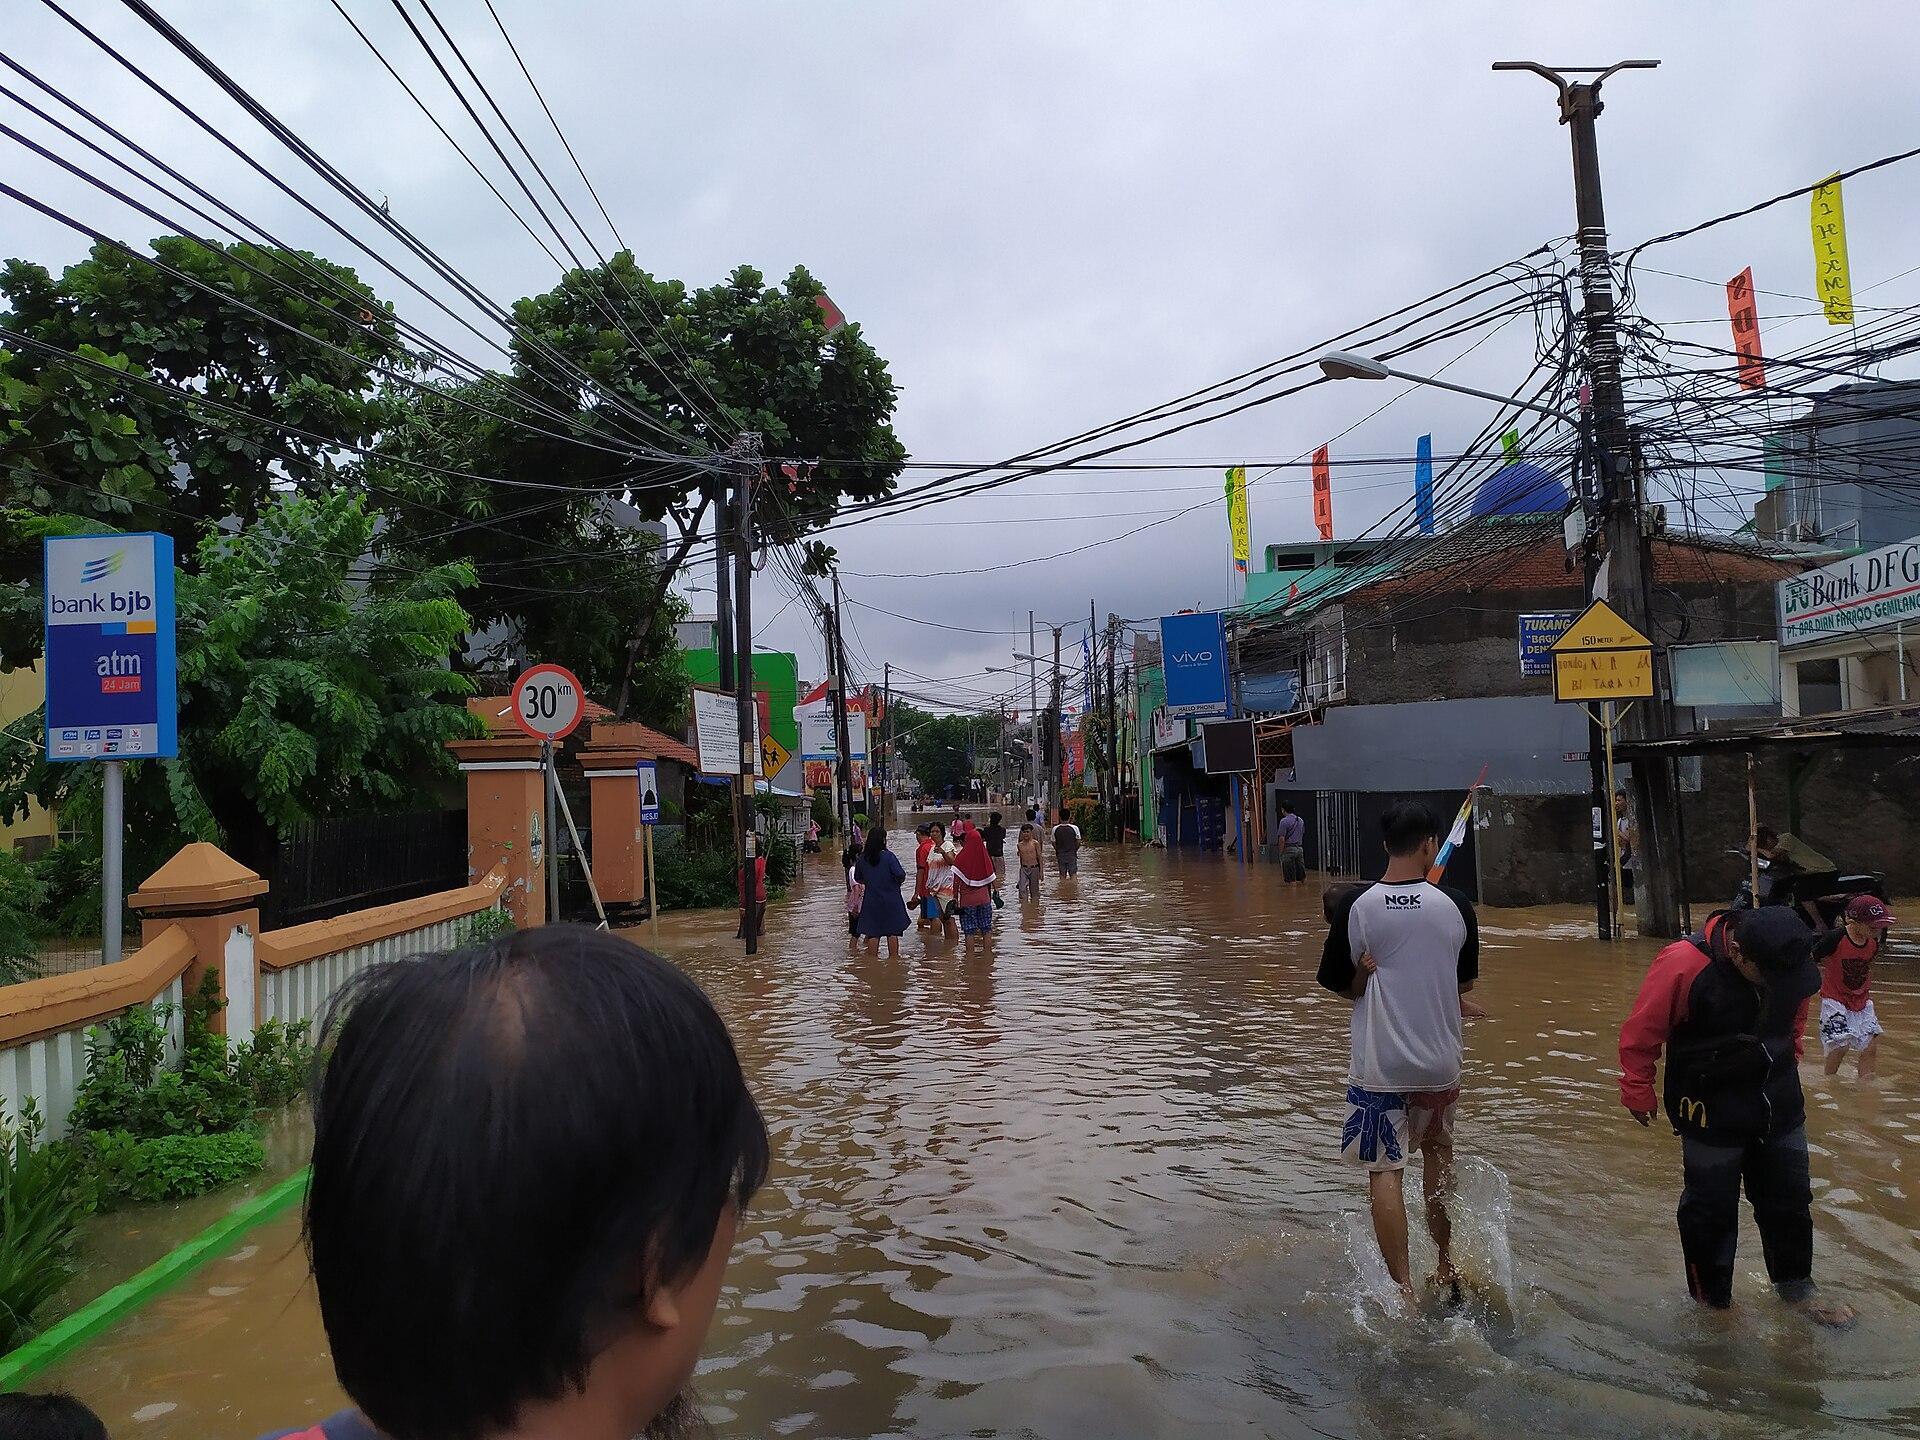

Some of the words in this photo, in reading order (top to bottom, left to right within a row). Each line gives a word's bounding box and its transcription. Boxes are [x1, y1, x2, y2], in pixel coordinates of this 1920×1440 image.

[1813, 563, 1859, 607] Bank
[1866, 545, 1920, 593] DFG
[51, 592, 105, 614] bank
[110, 591, 151, 615] bjb
[1525, 619, 1571, 631] TUKANG
[1582, 635, 1596, 646] 150
[97, 649, 141, 676] atm
[1172, 650, 1212, 663] vivo
[103, 680, 116, 690] 24
[119, 679, 140, 690] Jam
[525, 685, 557, 719] 30
[557, 683, 572, 696] km
[1384, 894, 1421, 906] NGK
